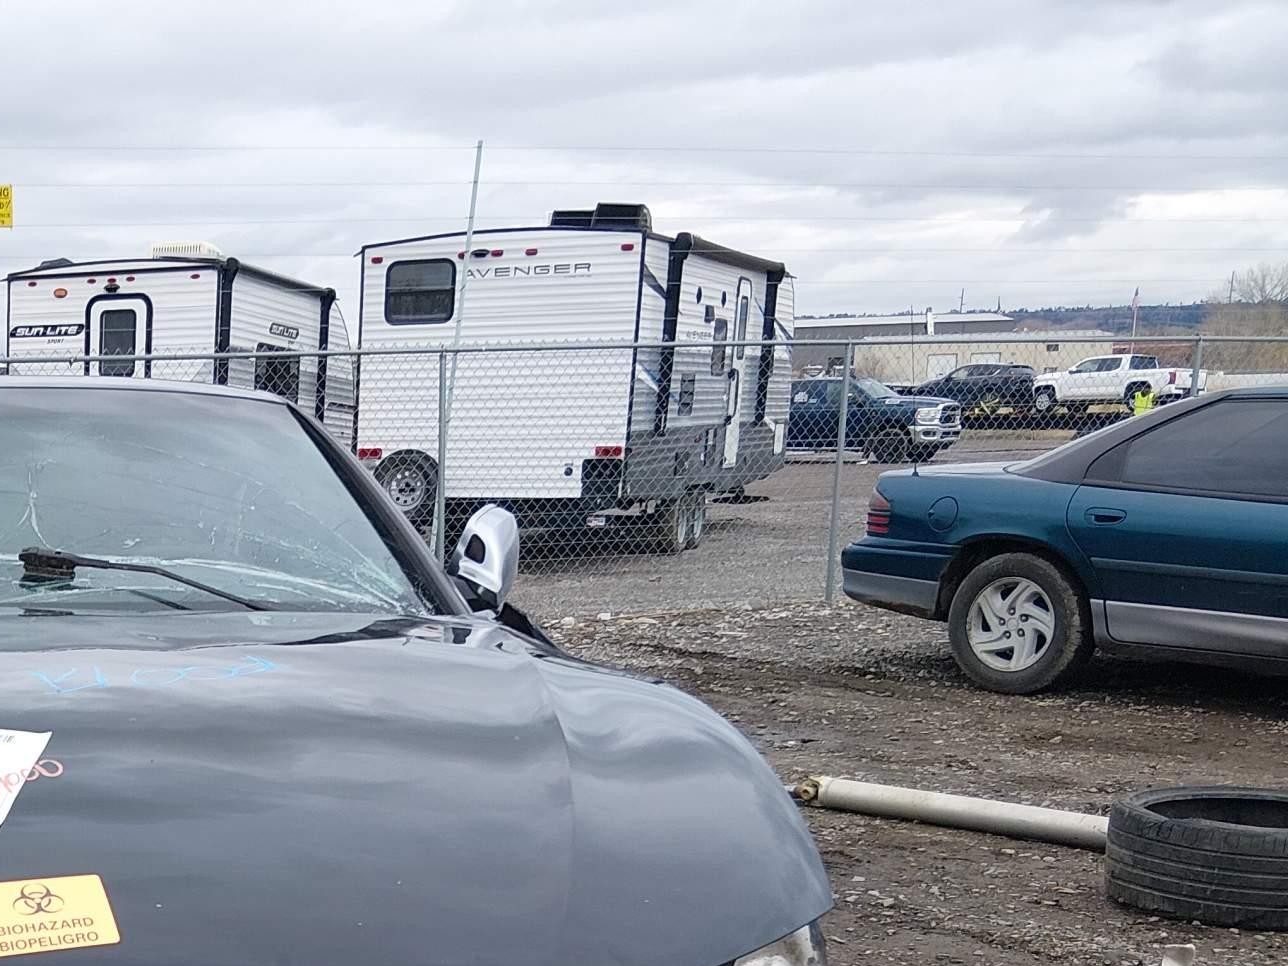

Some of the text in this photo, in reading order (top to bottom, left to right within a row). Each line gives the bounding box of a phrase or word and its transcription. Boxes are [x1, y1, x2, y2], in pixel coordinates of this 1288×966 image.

[467, 263, 592, 279] AVENGER
[15, 325, 79, 337] SUN LITE
[0, 931, 100, 952] BIOPELIGRO
